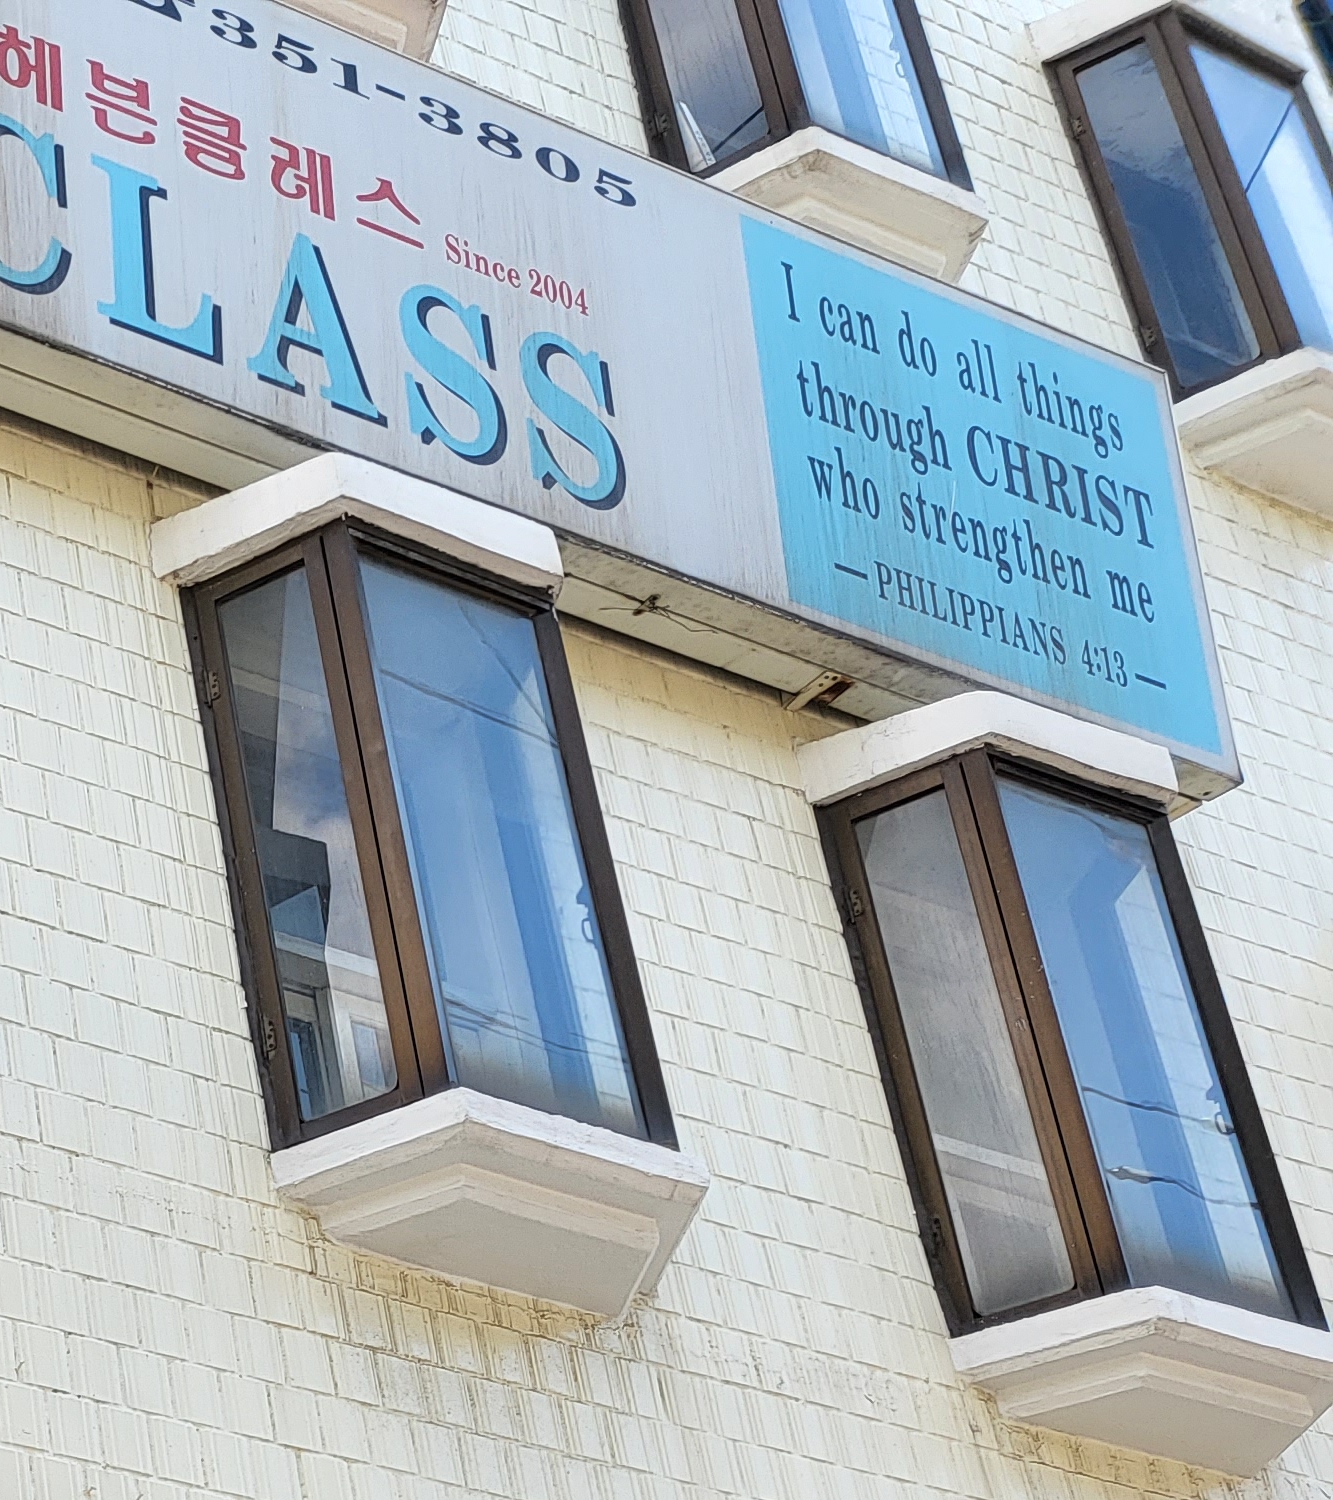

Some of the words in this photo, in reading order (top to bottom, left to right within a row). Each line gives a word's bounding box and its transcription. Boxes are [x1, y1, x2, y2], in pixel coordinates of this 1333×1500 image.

[209, 8, 637, 207] 351-3805
[444, 232, 522, 290] Since
[528, 267, 590, 317] 2004
[780, 260, 801, 323] I
[818, 293, 881, 355] can
[898, 310, 936, 377] do
[956, 338, 1002, 404] all
[1017, 361, 1124, 459] things
[796, 358, 952, 475] through
[966, 425, 1155, 550] CHRIST
[807, 446, 880, 521] who
[901, 482, 1091, 600] strengthen
[1106, 566, 1155, 623] me
[874, 559, 1067, 666] PHILIPPIANS
[1080, 638, 1129, 688] 4:13
